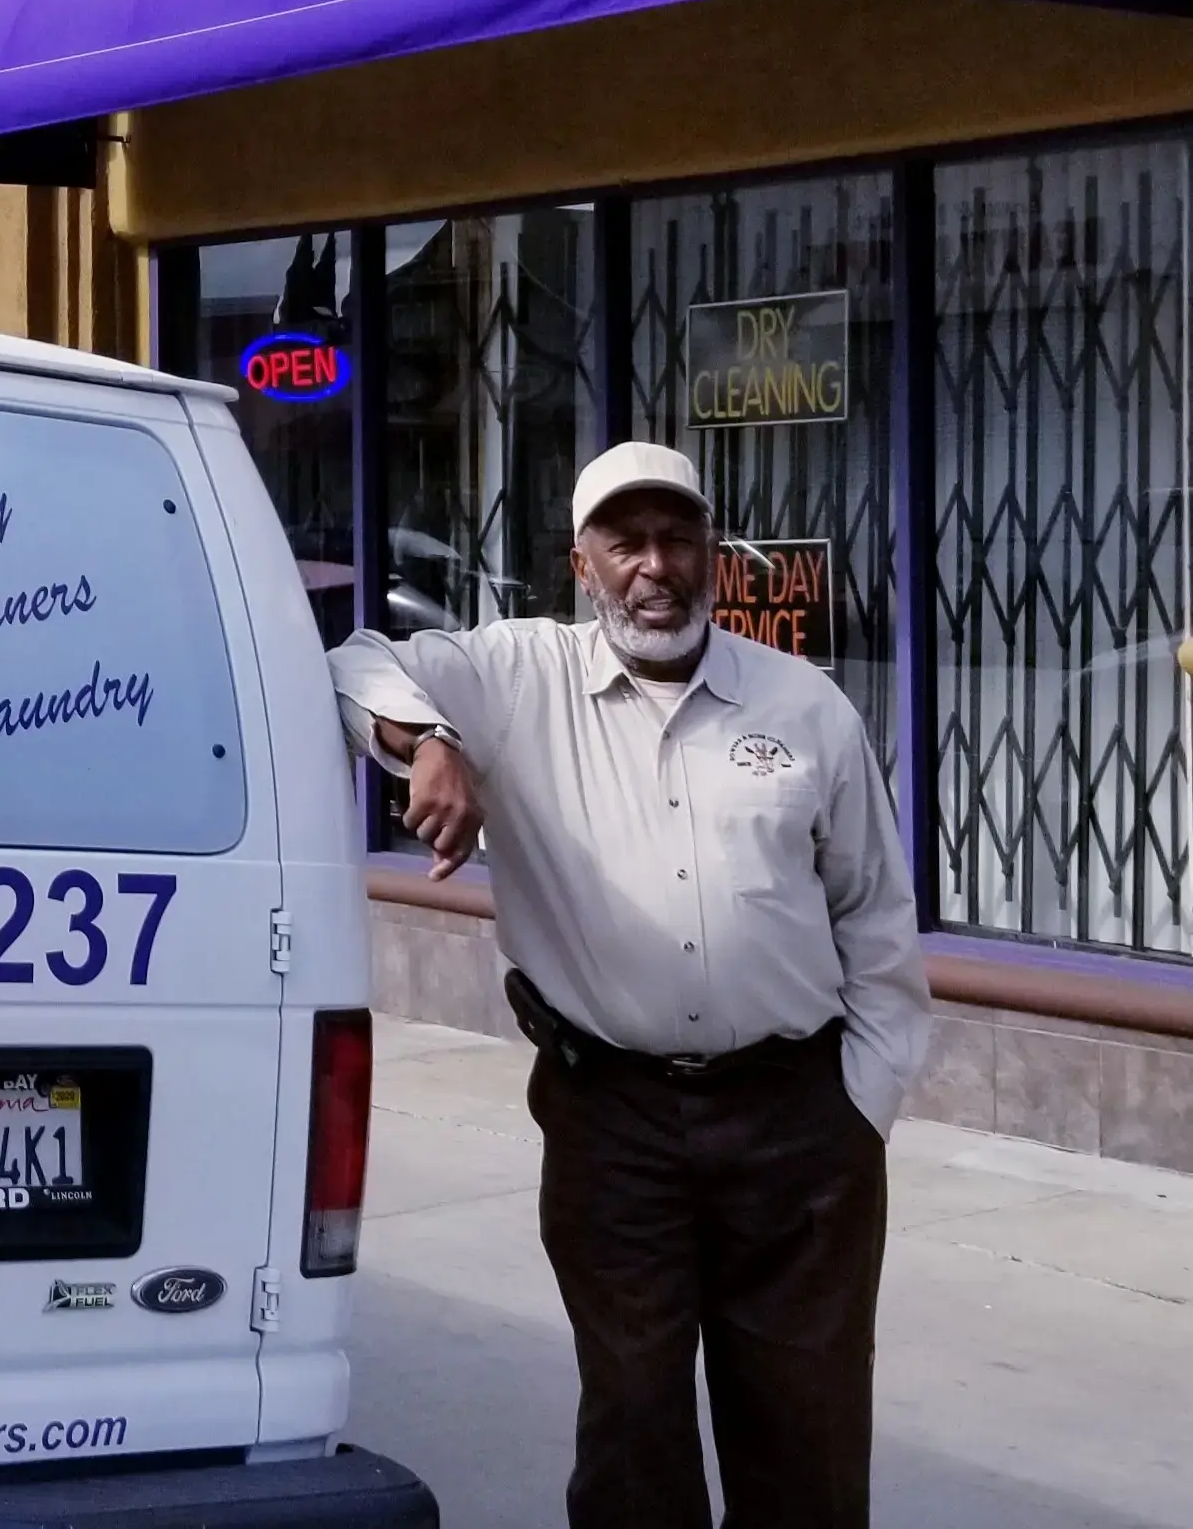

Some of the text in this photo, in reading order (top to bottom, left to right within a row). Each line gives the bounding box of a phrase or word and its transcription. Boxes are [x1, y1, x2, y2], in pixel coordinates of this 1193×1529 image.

[736, 304, 796, 361] DRY
[247, 346, 337, 390] OPEN
[692, 359, 842, 420] CLEANING
[767, 550, 824, 604] DAY
[50, 1190, 92, 1201] LINCOLN
[74, 1296, 115, 1308] FUEL
[157, 1277, 207, 1304] Ford
